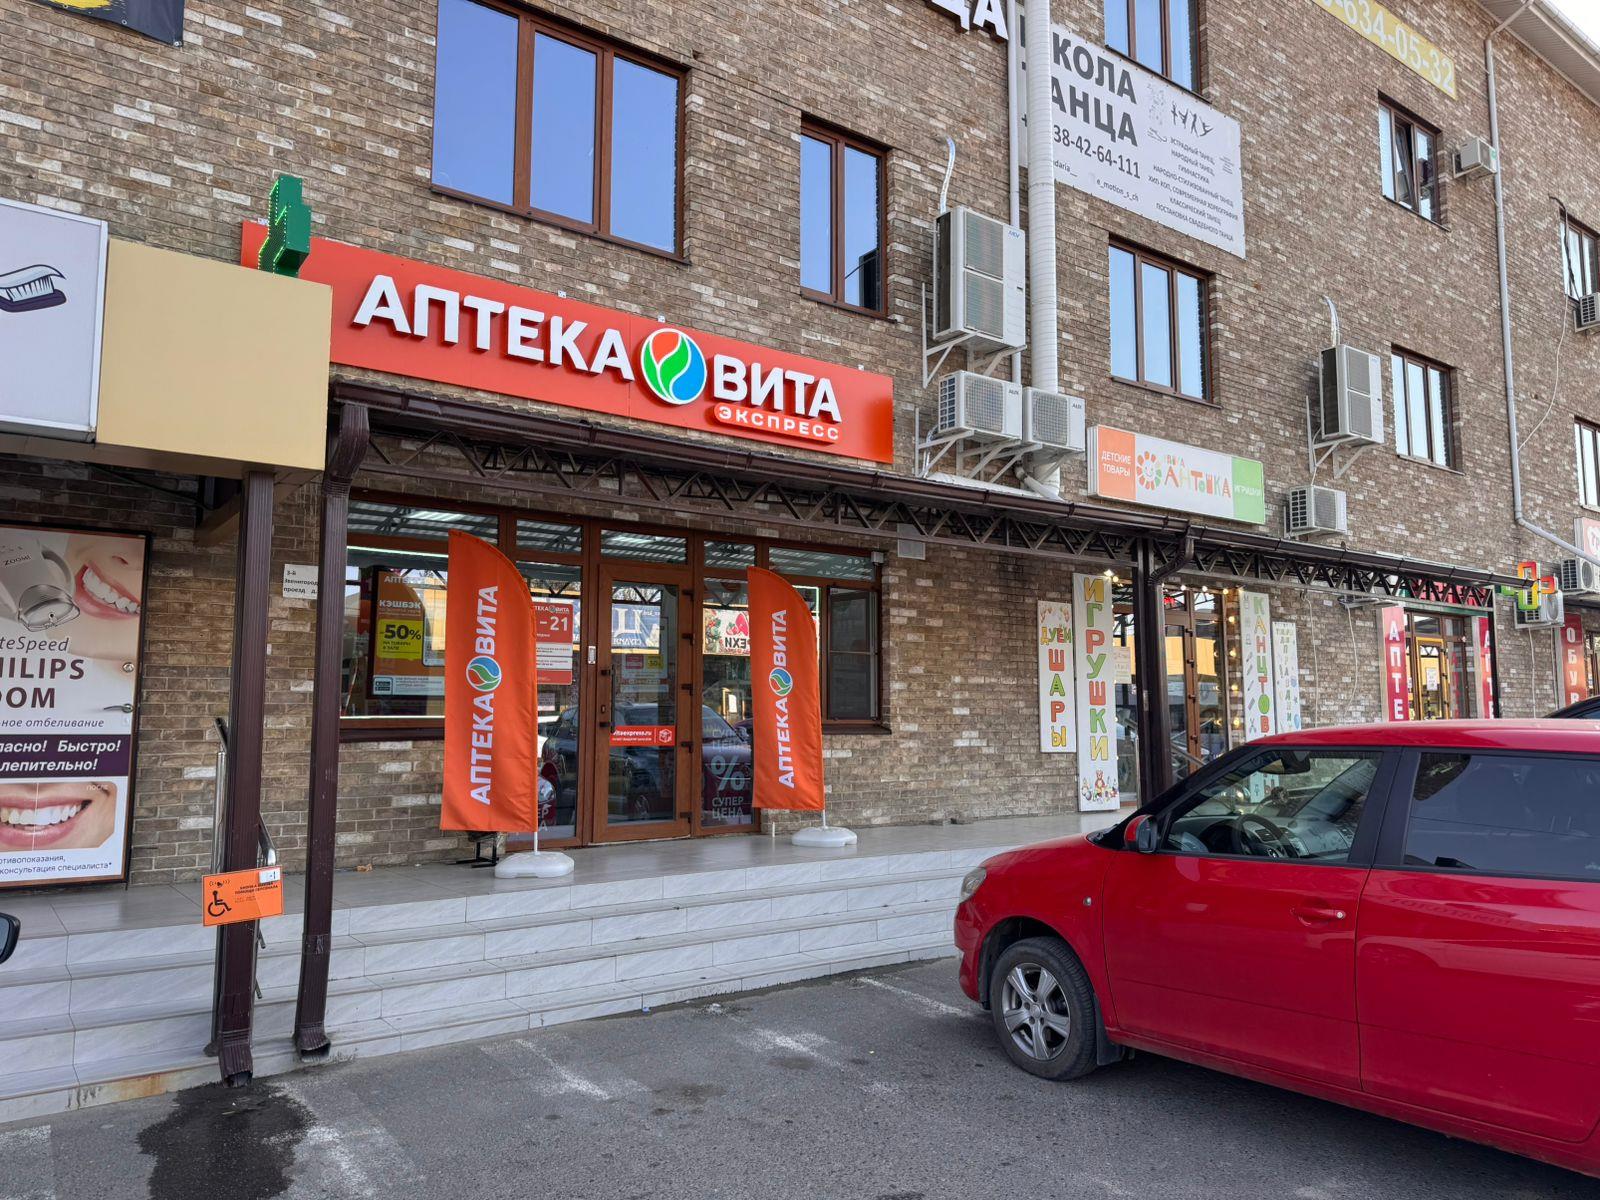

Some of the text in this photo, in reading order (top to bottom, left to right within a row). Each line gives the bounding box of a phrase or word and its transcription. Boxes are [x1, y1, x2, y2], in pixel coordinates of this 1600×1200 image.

[1053, 32, 1137, 105] КОЛА
[1051, 76, 1138, 147] АНЦА
[1053, 125, 1141, 179] 38-42-64-111
[353, 274, 635, 381] АПТЕКА
[714, 354, 842, 423] ВИТА
[718, 405, 840, 441] ЭКСПРЕСС
[1101, 450, 1131, 464] ДЕТСКИЕ
[1103, 463, 1131, 477] ТОВАРЫ
[379, 599, 421, 609] КЭШБЭК
[0, 686, 55, 708] OM
[470, 585, 498, 805] АПТЕКА ВИТА
[772, 609, 795, 789] АПТЕКА ВИТА
[1048, 648, 1067, 747] ШАРЫ
[1084, 578, 1108, 761] ИГРУШКИ
[1254, 597, 1270, 737] КАНЦТОВ
[26, 717, 105, 728] отбеливание
[57, 740, 121, 754] Быстро!
